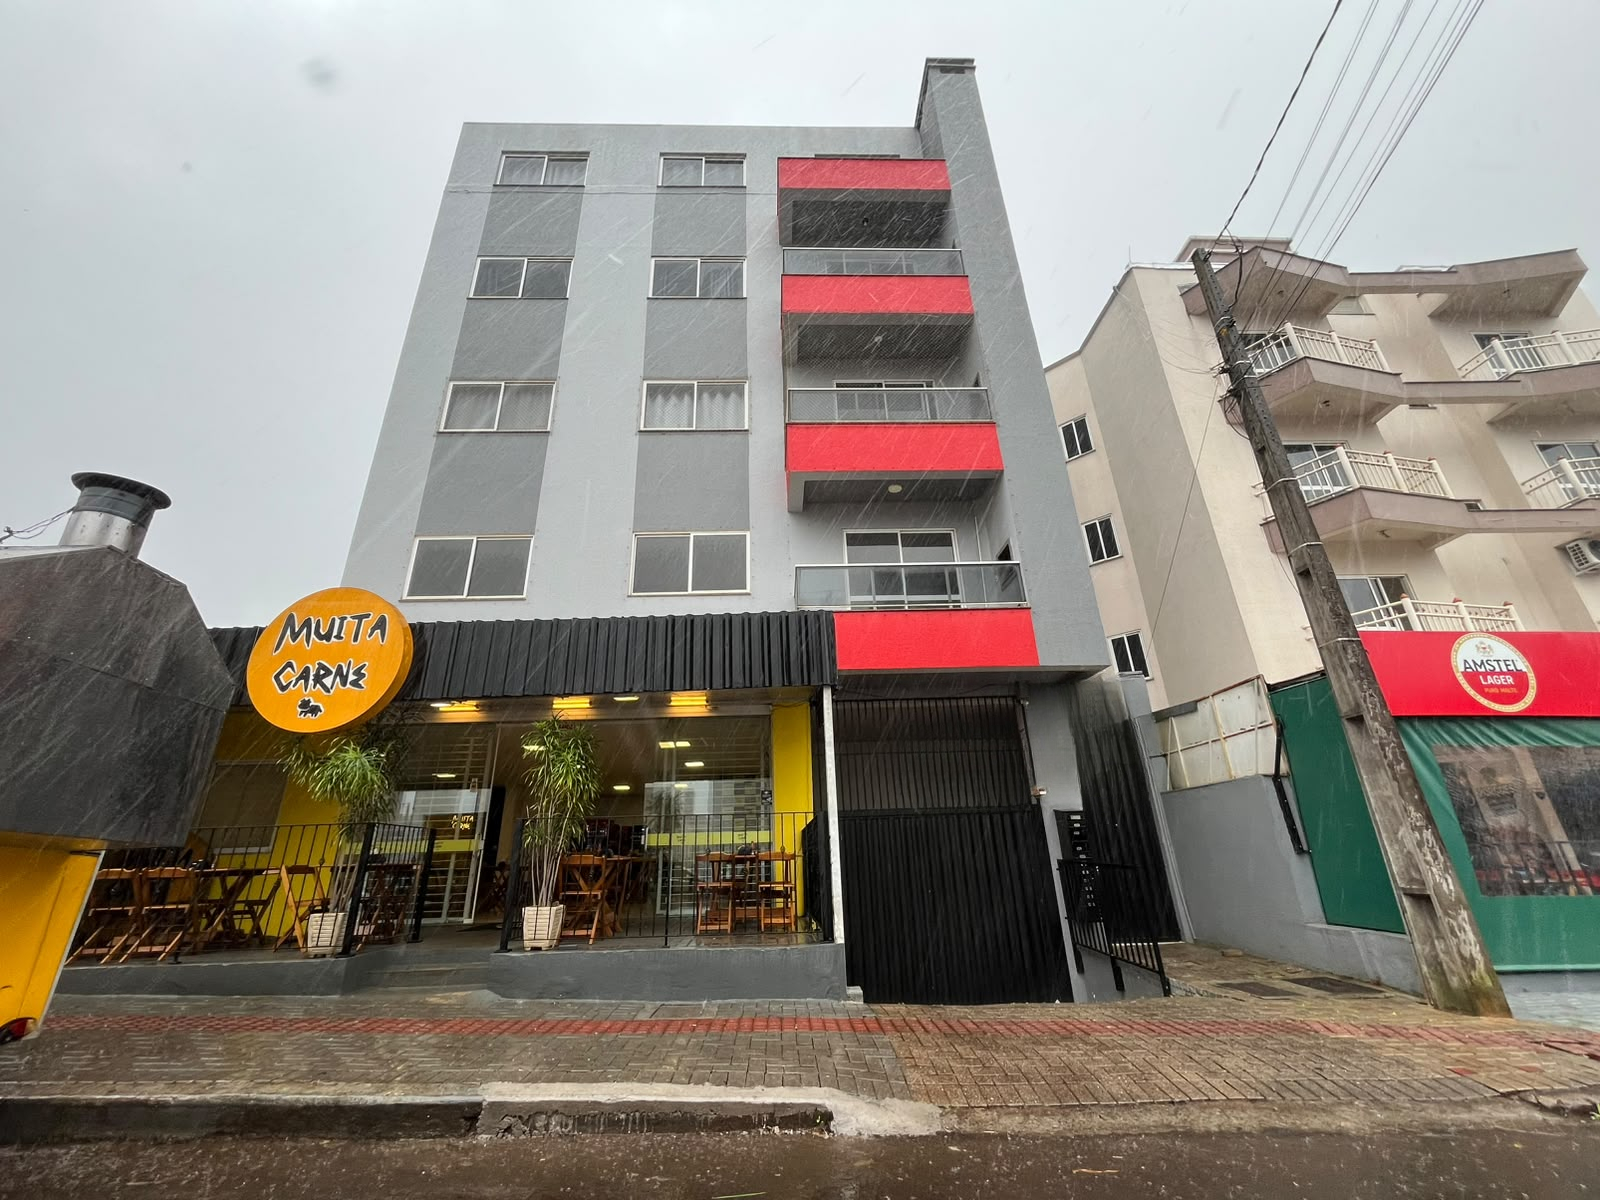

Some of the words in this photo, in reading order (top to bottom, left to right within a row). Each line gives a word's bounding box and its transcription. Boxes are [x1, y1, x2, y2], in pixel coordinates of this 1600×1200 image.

[273, 612, 388, 655] MUITA
[272, 660, 368, 694] CARNE
[1463, 659, 1522, 672] AMSTEL
[1479, 675, 1515, 685] LAGER
